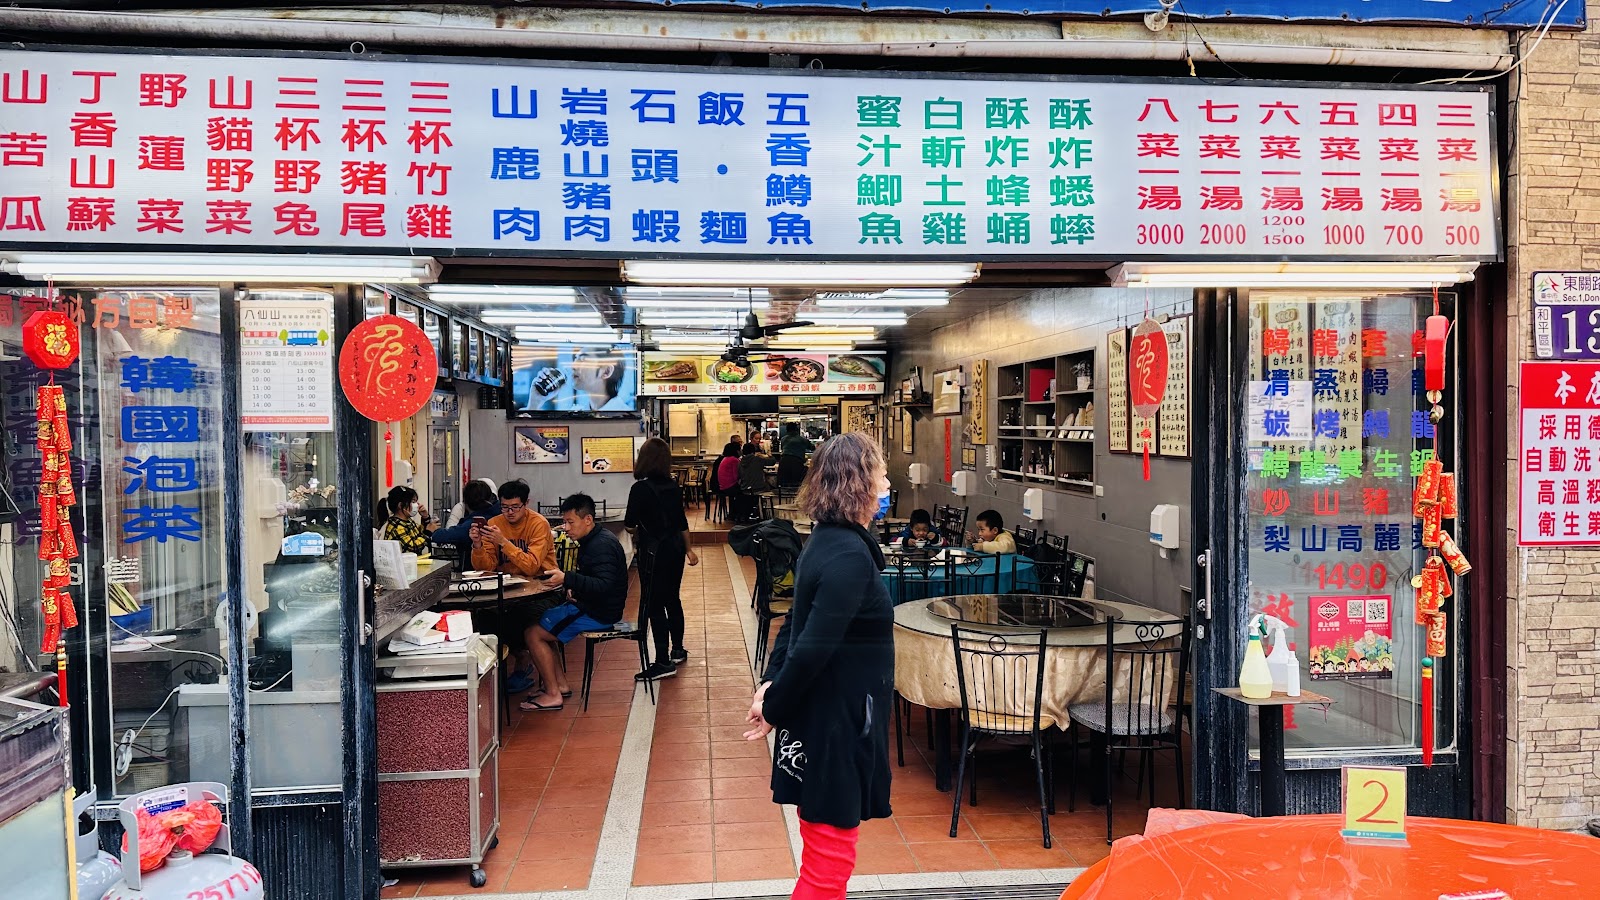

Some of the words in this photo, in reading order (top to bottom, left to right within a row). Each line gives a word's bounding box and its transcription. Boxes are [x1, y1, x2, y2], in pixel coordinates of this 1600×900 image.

[0, 70, 47, 231] 山苦瓜
[67, 71, 117, 231] 丁香山蘇
[137, 74, 187, 233] 野蓮菜
[206, 76, 253, 234] 山貓野菜
[274, 78, 320, 236] 三杯野兔
[340, 80, 387, 237] 三杯豬尾
[407, 82, 452, 238] 三杯竹雞
[491, 86, 540, 241] 山鹿肉
[560, 88, 611, 242] 岩燒山豬肉
[630, 89, 680, 243] 石頭蝦
[766, 93, 813, 245] 五香鱒魚
[857, 95, 902, 244] 蜜汁鯽魚
[922, 97, 966, 244] 白斬土雞
[985, 98, 1030, 244] 酥炸蜂蛹
[1049, 99, 1094, 244] 酥炸蟋蟀
[1138, 98, 1181, 210] 八菜一湯
[1198, 100, 1242, 210] 七菜一湯
[1260, 101, 1303, 210] 六菜一湯
[1320, 102, 1363, 211] 五菜一湯
[1379, 104, 1422, 211] 四菜一湯
[1437, 105, 1480, 212] 三菜一湯
[1137, 223, 1185, 245] 3000
[1200, 223, 1247, 245] 2000
[1262, 215, 1305, 226] 1200
[1263, 234, 1305, 245] 1500
[1324, 224, 1365, 245] 1000
[1383, 225, 1423, 245] 700
[1445, 225, 1480, 245] 500
[244, 309, 280, 319] 八仙山
[1537, 308, 1549, 346] 和平區
[120, 356, 202, 543] 韓國泡菜
[1262, 488, 1418, 516] 炒山豬
[1526, 447, 1600, 472] 自動洗
[1314, 563, 1387, 590] 1490
[1357, 780, 1398, 824] 2
